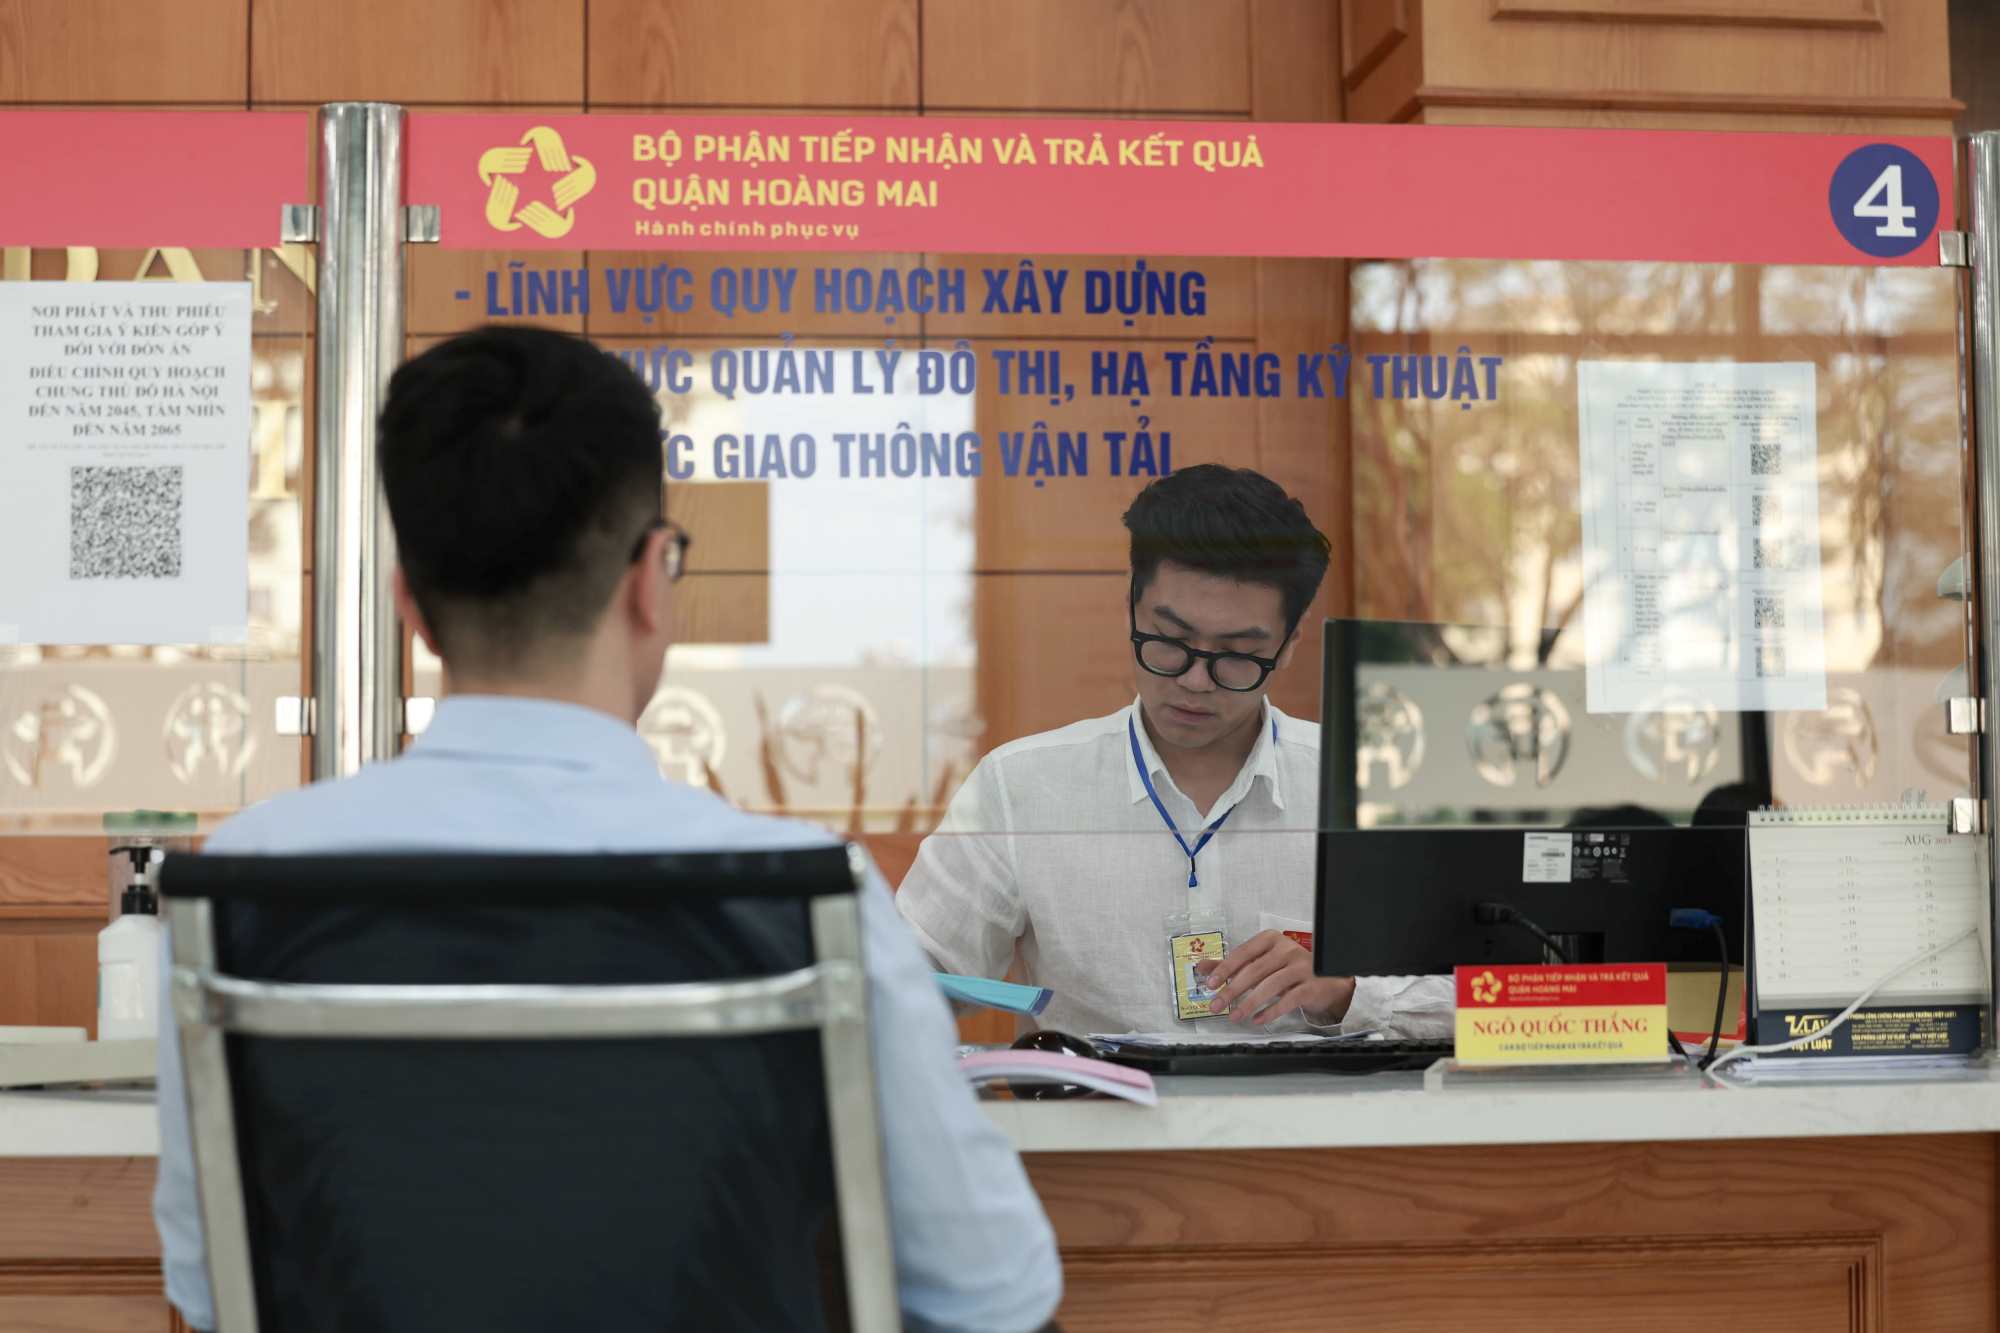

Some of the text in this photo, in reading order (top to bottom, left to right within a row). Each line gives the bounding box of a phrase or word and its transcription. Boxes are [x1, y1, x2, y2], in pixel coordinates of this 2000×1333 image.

[633, 128, 1265, 173] BỘ PHẬN TIẾP NHẬN VÀ TRẢ KẾT QUẢ
[632, 173, 938, 212] QUẬN HOÀNG MAI
[1853, 165, 1917, 237] 4
[635, 219, 860, 240] Hành chính phục vụ
[486, 261, 590, 317] LĨNH
[605, 263, 694, 323] VỰC
[710, 267, 798, 319] QUY
[813, 267, 967, 324] HOẠCH
[981, 259, 1068, 314] XÂY
[1085, 260, 1207, 327] DỰNG
[33, 324, 79, 337] THAM
[84, 324, 113, 337] GIA
[128, 366, 162, 381] QUY
[711, 332, 837, 400] QUẢN
[850, 339, 904, 395] LÝ
[915, 341, 977, 396] ĐÔ
[992, 349, 1076, 407] THỊ,
[1091, 351, 1150, 407] HẠ
[1164, 335, 1282, 398] TẦNG
[1297, 343, 1352, 398] KỸ
[1366, 345, 1503, 410] THUẬT
[36, 385, 93, 398] CHUNG
[713, 431, 818, 481] GIAO
[832, 422, 983, 481] THÔNG
[999, 421, 1089, 488] VẬN
[1103, 415, 1172, 478] TẢI
[1472, 1015, 1516, 1035] NGÔ
[1520, 1011, 1577, 1037] QUỐC
